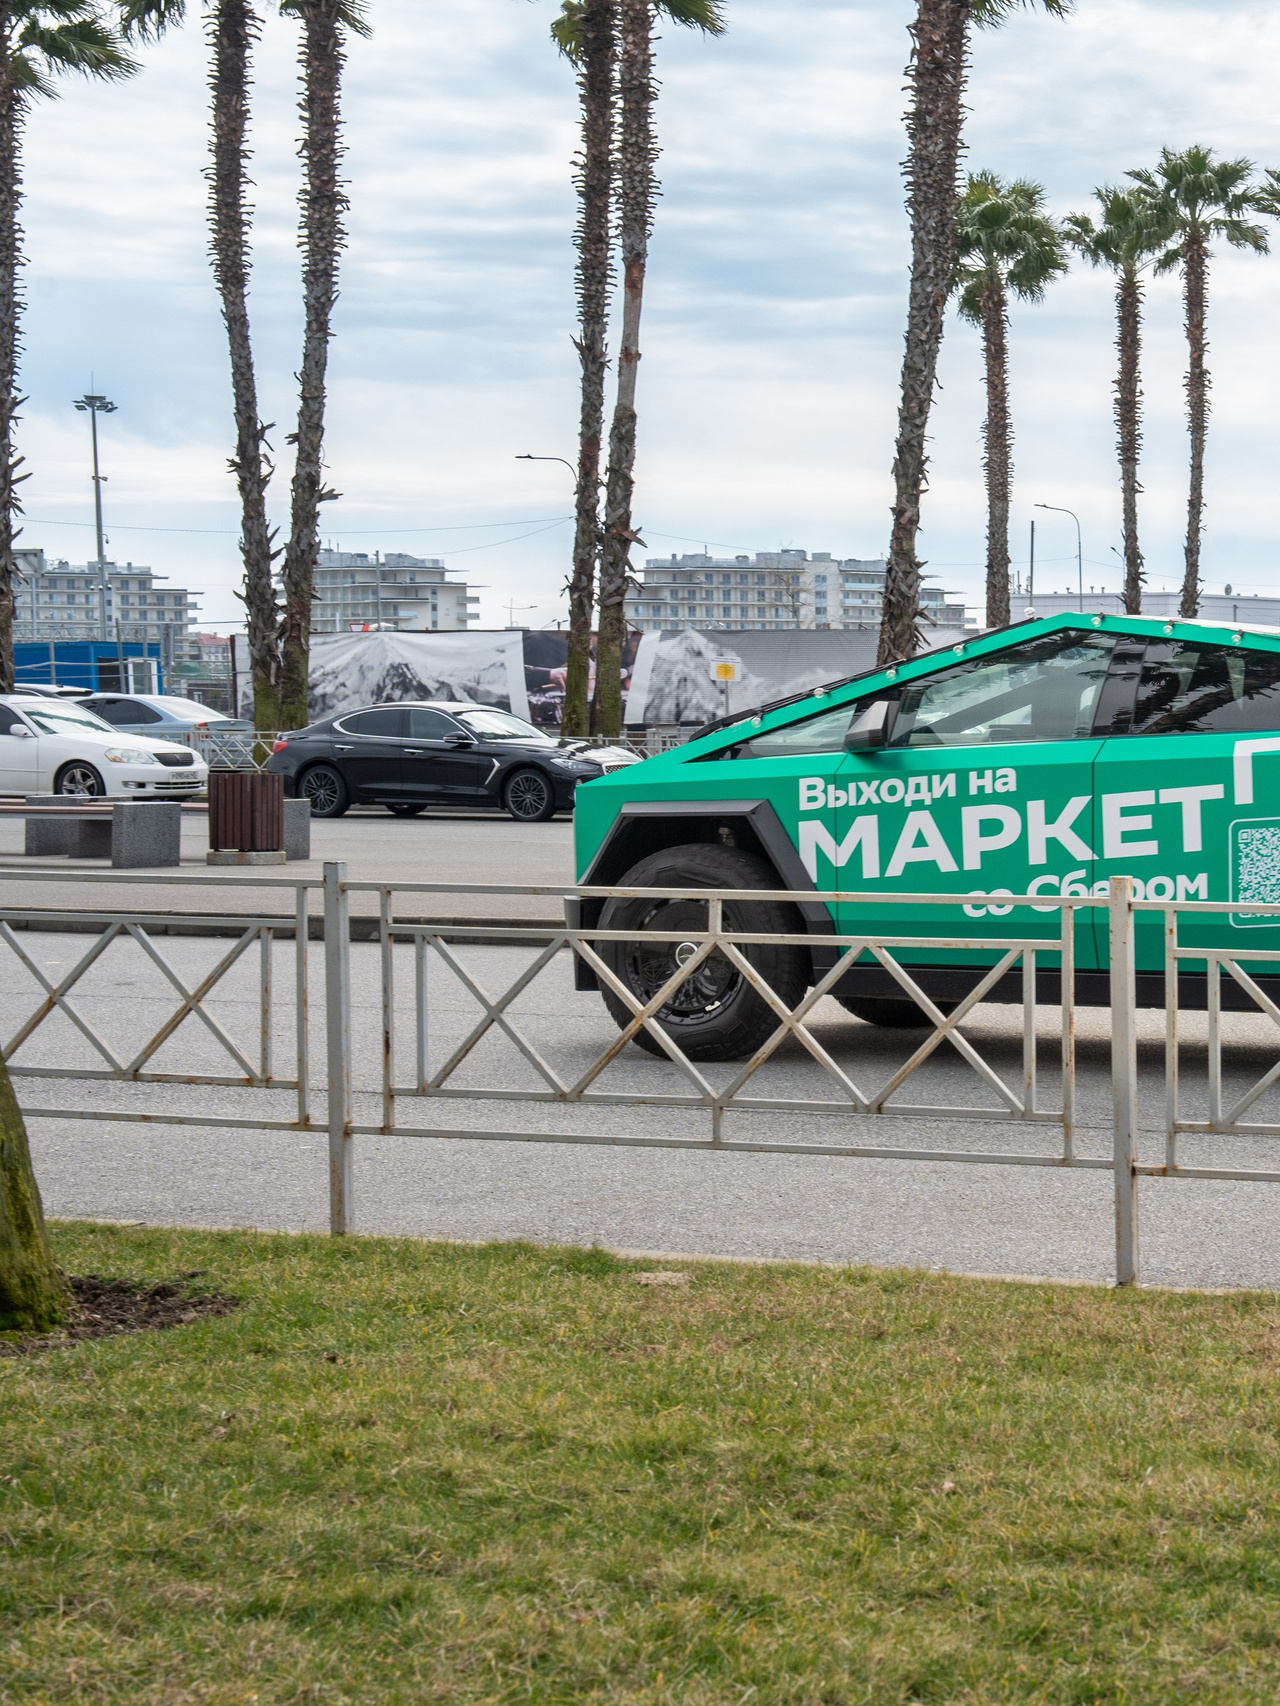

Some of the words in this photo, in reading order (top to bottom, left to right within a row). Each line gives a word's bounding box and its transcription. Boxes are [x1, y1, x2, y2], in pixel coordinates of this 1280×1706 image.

[799, 773, 956, 810] Выходи
[969, 768, 1017, 795] на
[798, 784, 1224, 883] МАРКЕТ
[962, 889, 1015, 917] со
